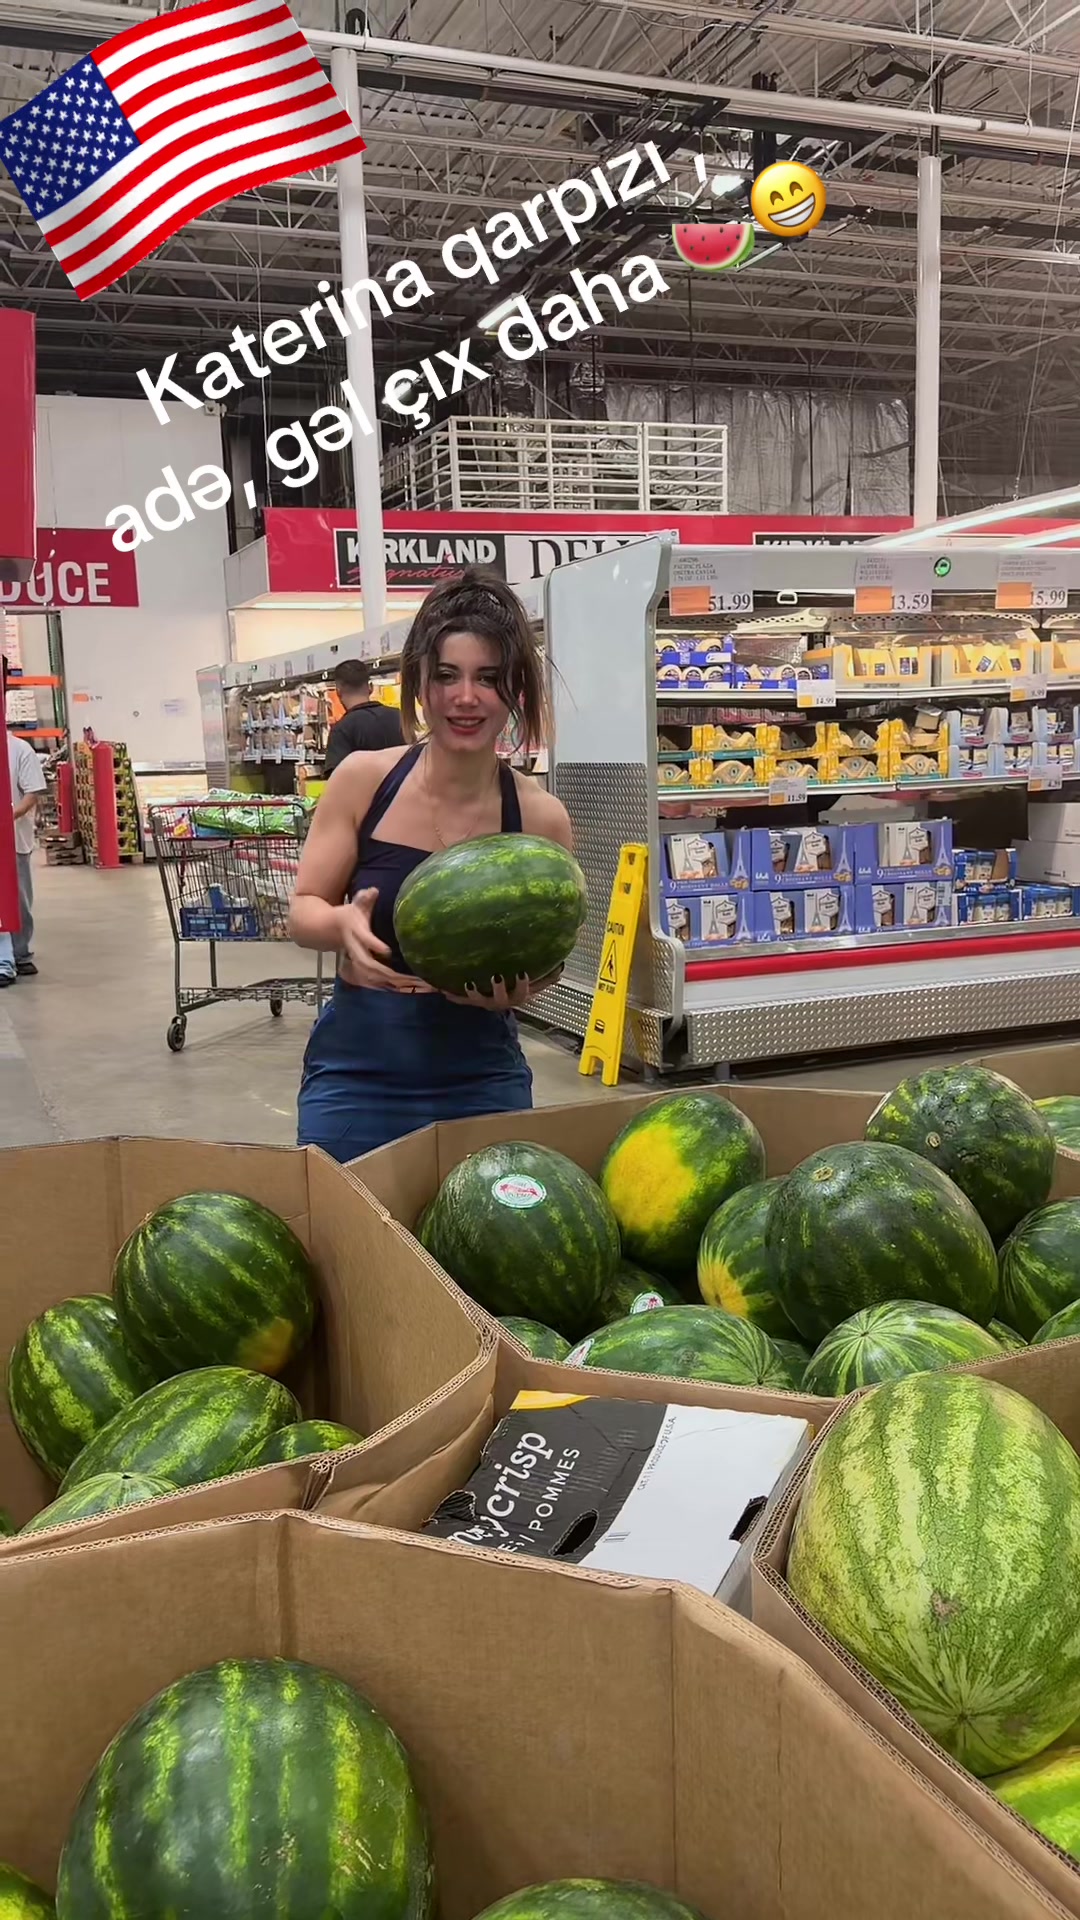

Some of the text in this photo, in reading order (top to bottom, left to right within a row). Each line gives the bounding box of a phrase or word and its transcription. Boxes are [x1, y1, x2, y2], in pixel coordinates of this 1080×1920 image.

[346, 537, 498, 564] KRKLAND
[708, 594, 751, 612] 51.99
[891, 593, 930, 610] 13.59
[1031, 590, 1066, 606] 15.99
[607, 921, 625, 936] CAUTION
[528, 1447, 581, 1532] POMMES
